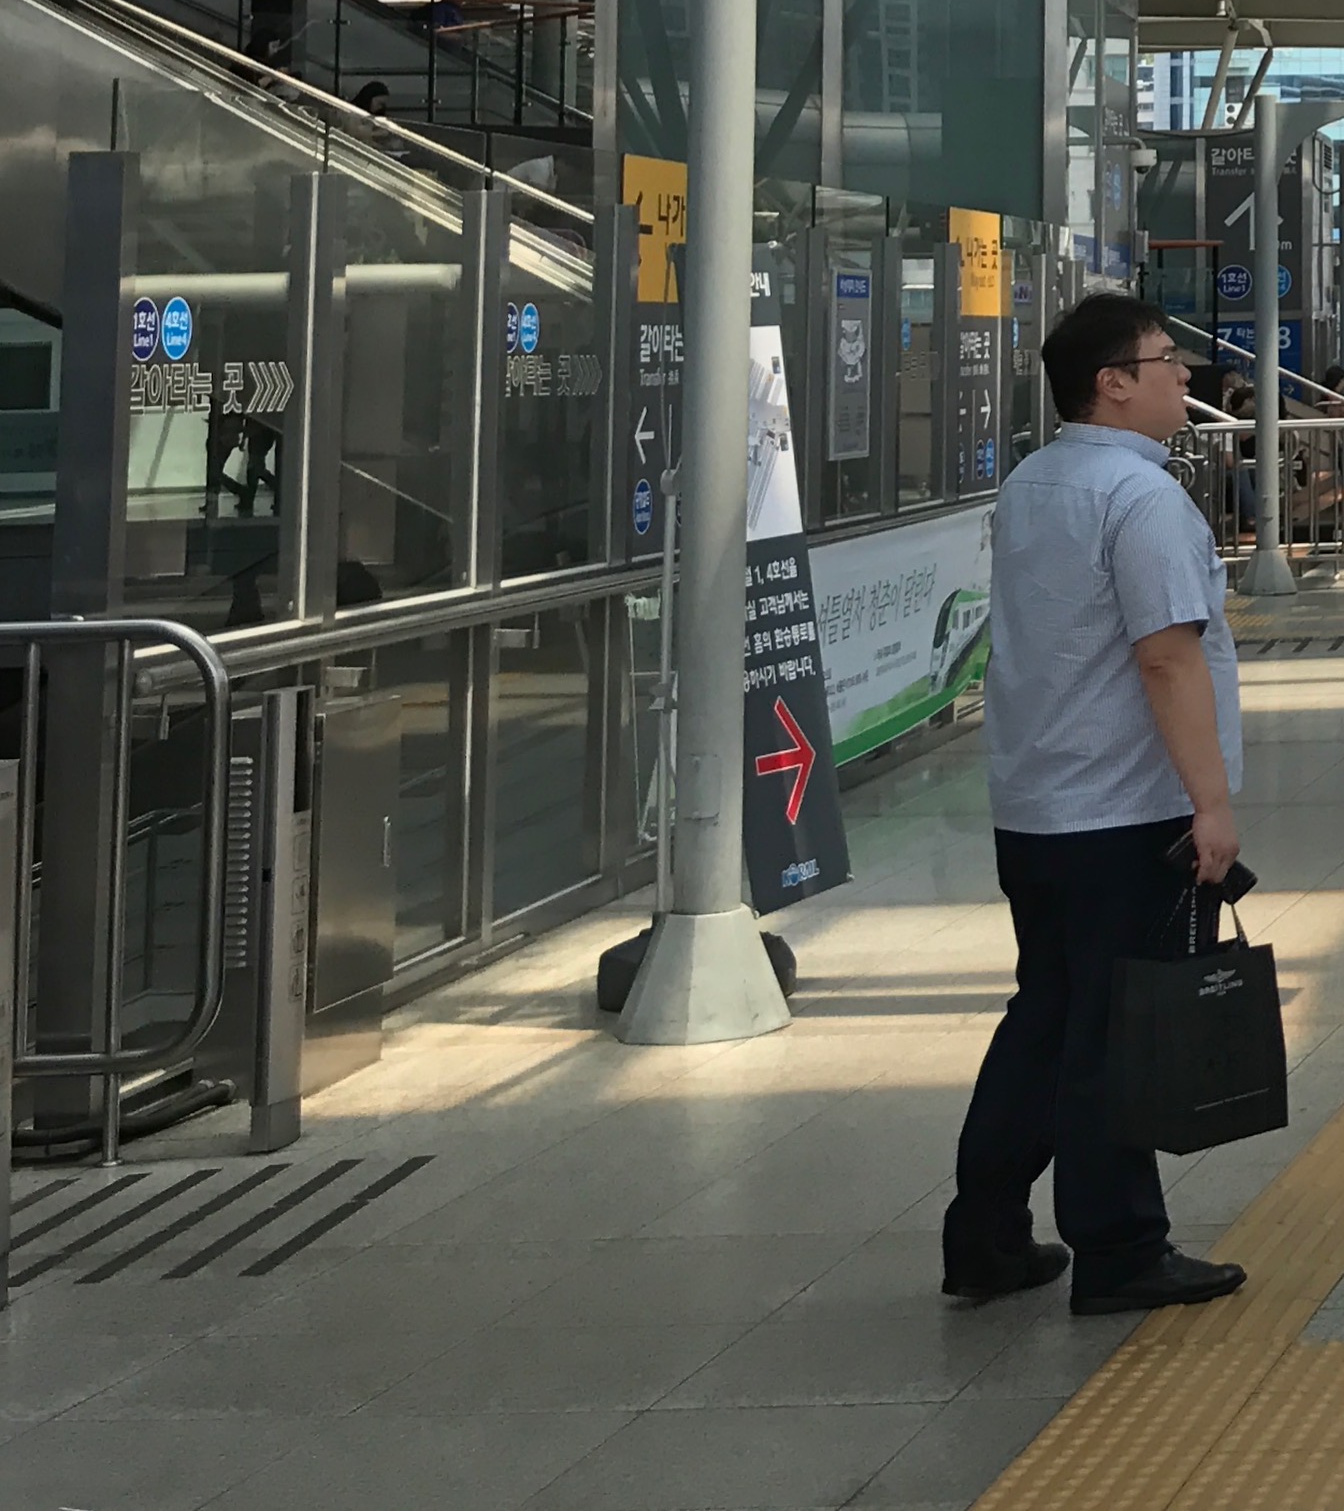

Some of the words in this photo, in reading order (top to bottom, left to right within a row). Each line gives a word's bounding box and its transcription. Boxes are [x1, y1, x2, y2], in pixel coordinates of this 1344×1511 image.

[1220, 272, 1248, 284] 1호선
[133, 311, 156, 331] 1호선
[165, 311, 188, 330] 4호선
[133, 333, 153, 348] Line1
[167, 332, 188, 347] Line4
[639, 324, 684, 363] 갈아타는
[557, 354, 572, 397] 곳
[223, 361, 245, 416] 곳
[766, 557, 798, 582] 4호선을
[774, 621, 816, 650] 환승통로를
[777, 655, 817, 682] 바랍니다.
